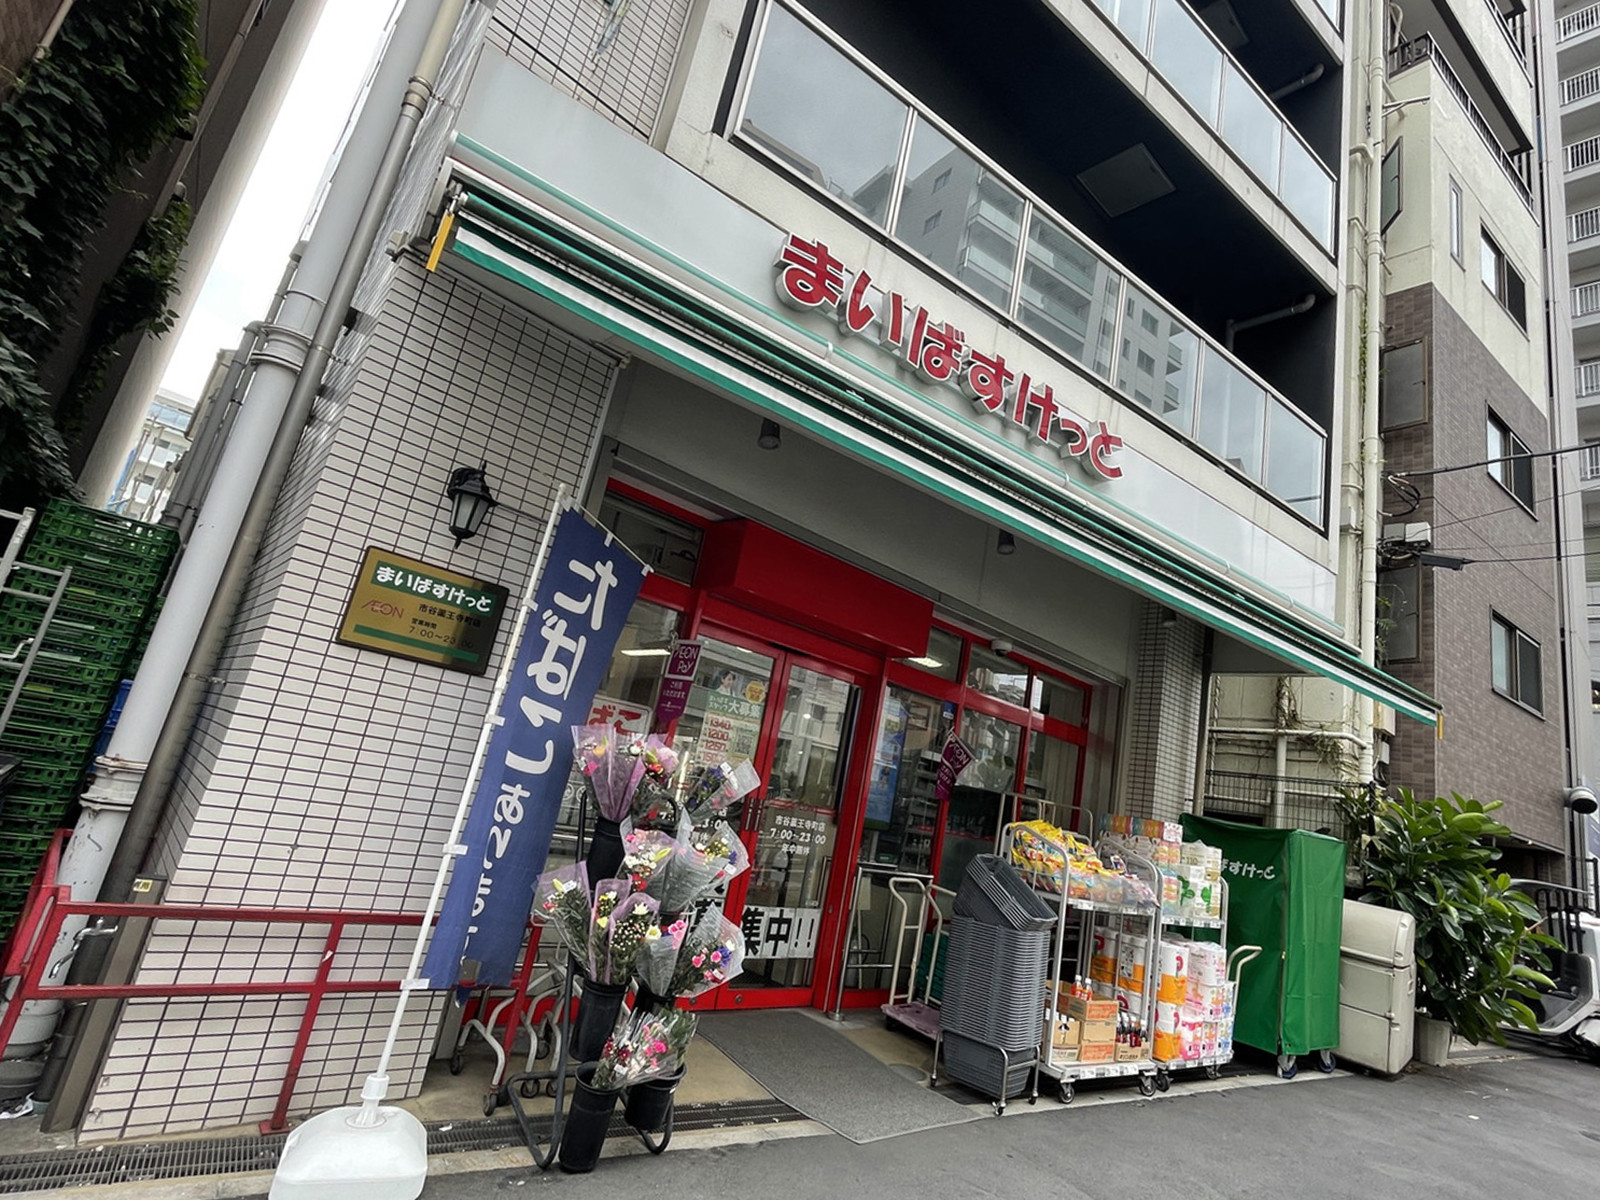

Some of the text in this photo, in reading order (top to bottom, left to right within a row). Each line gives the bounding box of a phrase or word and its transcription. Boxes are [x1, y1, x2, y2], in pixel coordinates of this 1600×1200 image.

[778, 231, 1124, 480] まいばすけっと
[376, 566, 492, 612] まいばすけっと
[408, 626, 475, 650] 7:00~2300
